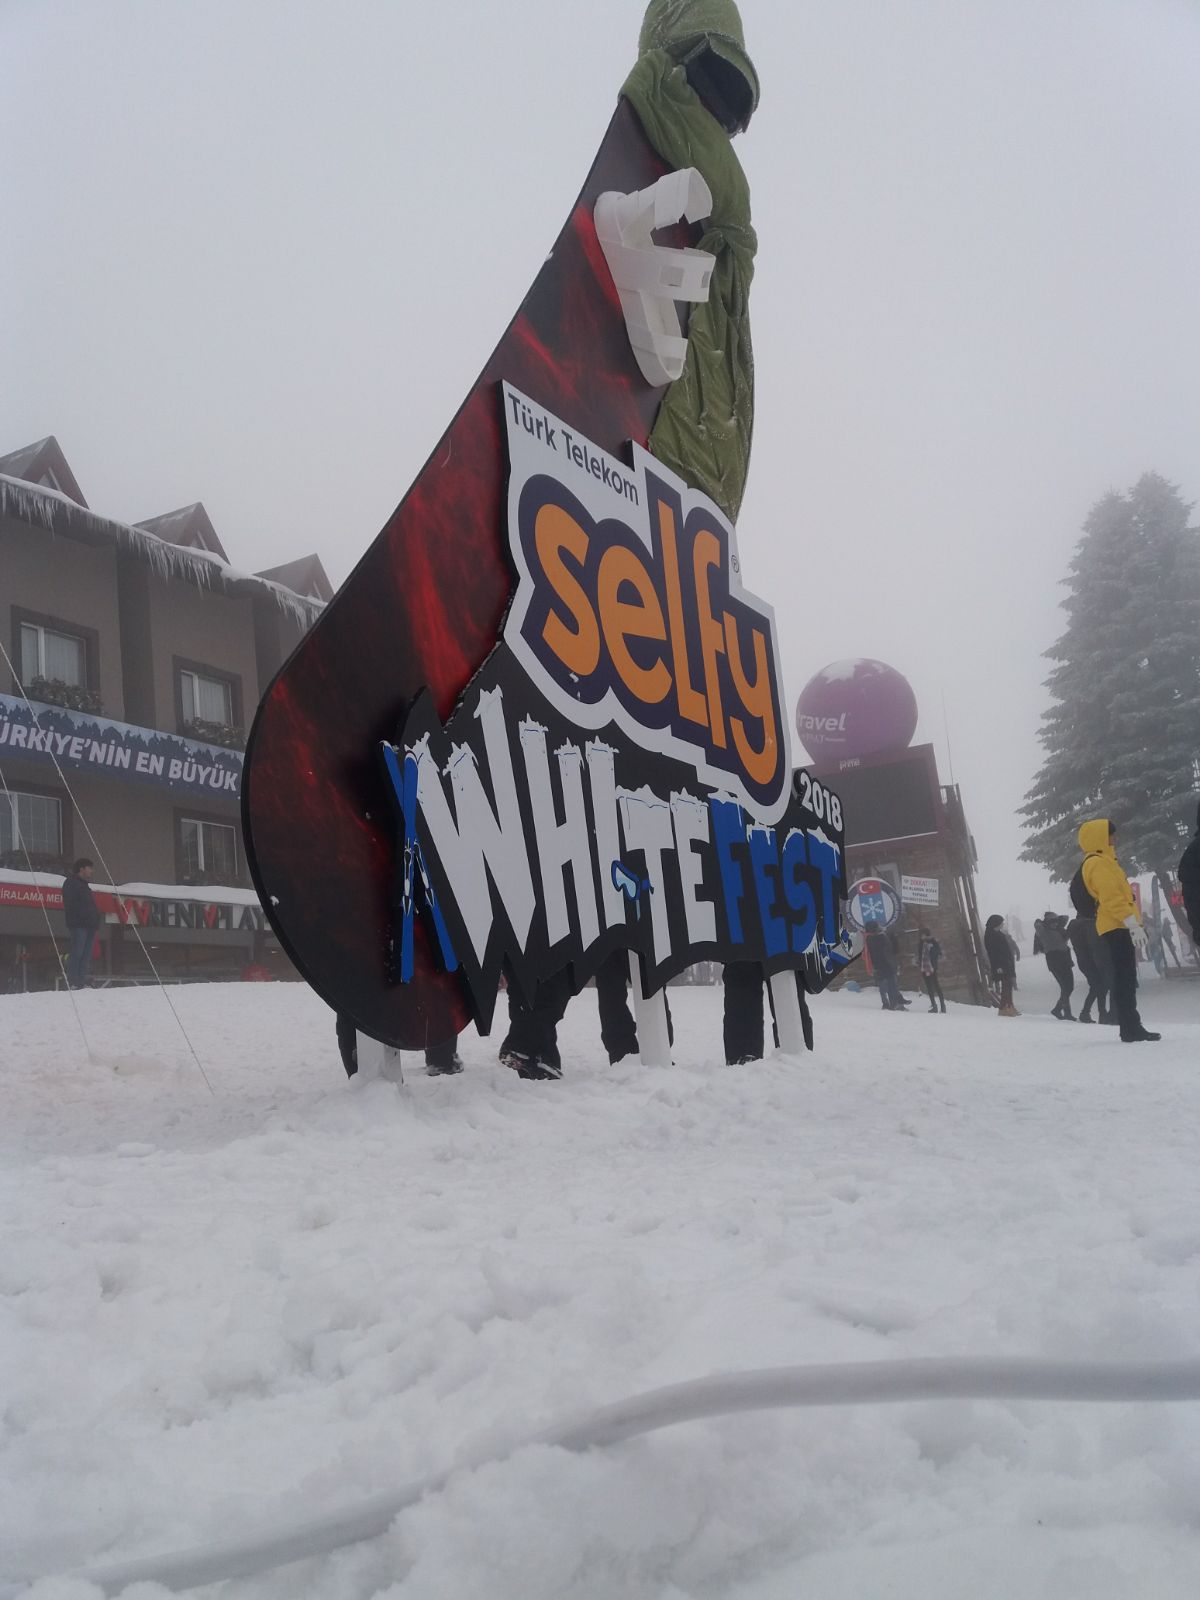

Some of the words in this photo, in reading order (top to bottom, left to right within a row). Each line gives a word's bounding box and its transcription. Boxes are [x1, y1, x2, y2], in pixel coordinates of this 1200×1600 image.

[508, 392, 557, 451] Türk
[561, 429, 639, 505] Telekom
[135, 751, 165, 777] EN
[168, 757, 239, 792] BÜYÜK
[403, 684, 718, 970] WHITE
[800, 772, 843, 832] 2018
[709, 790, 841, 958] FEST
